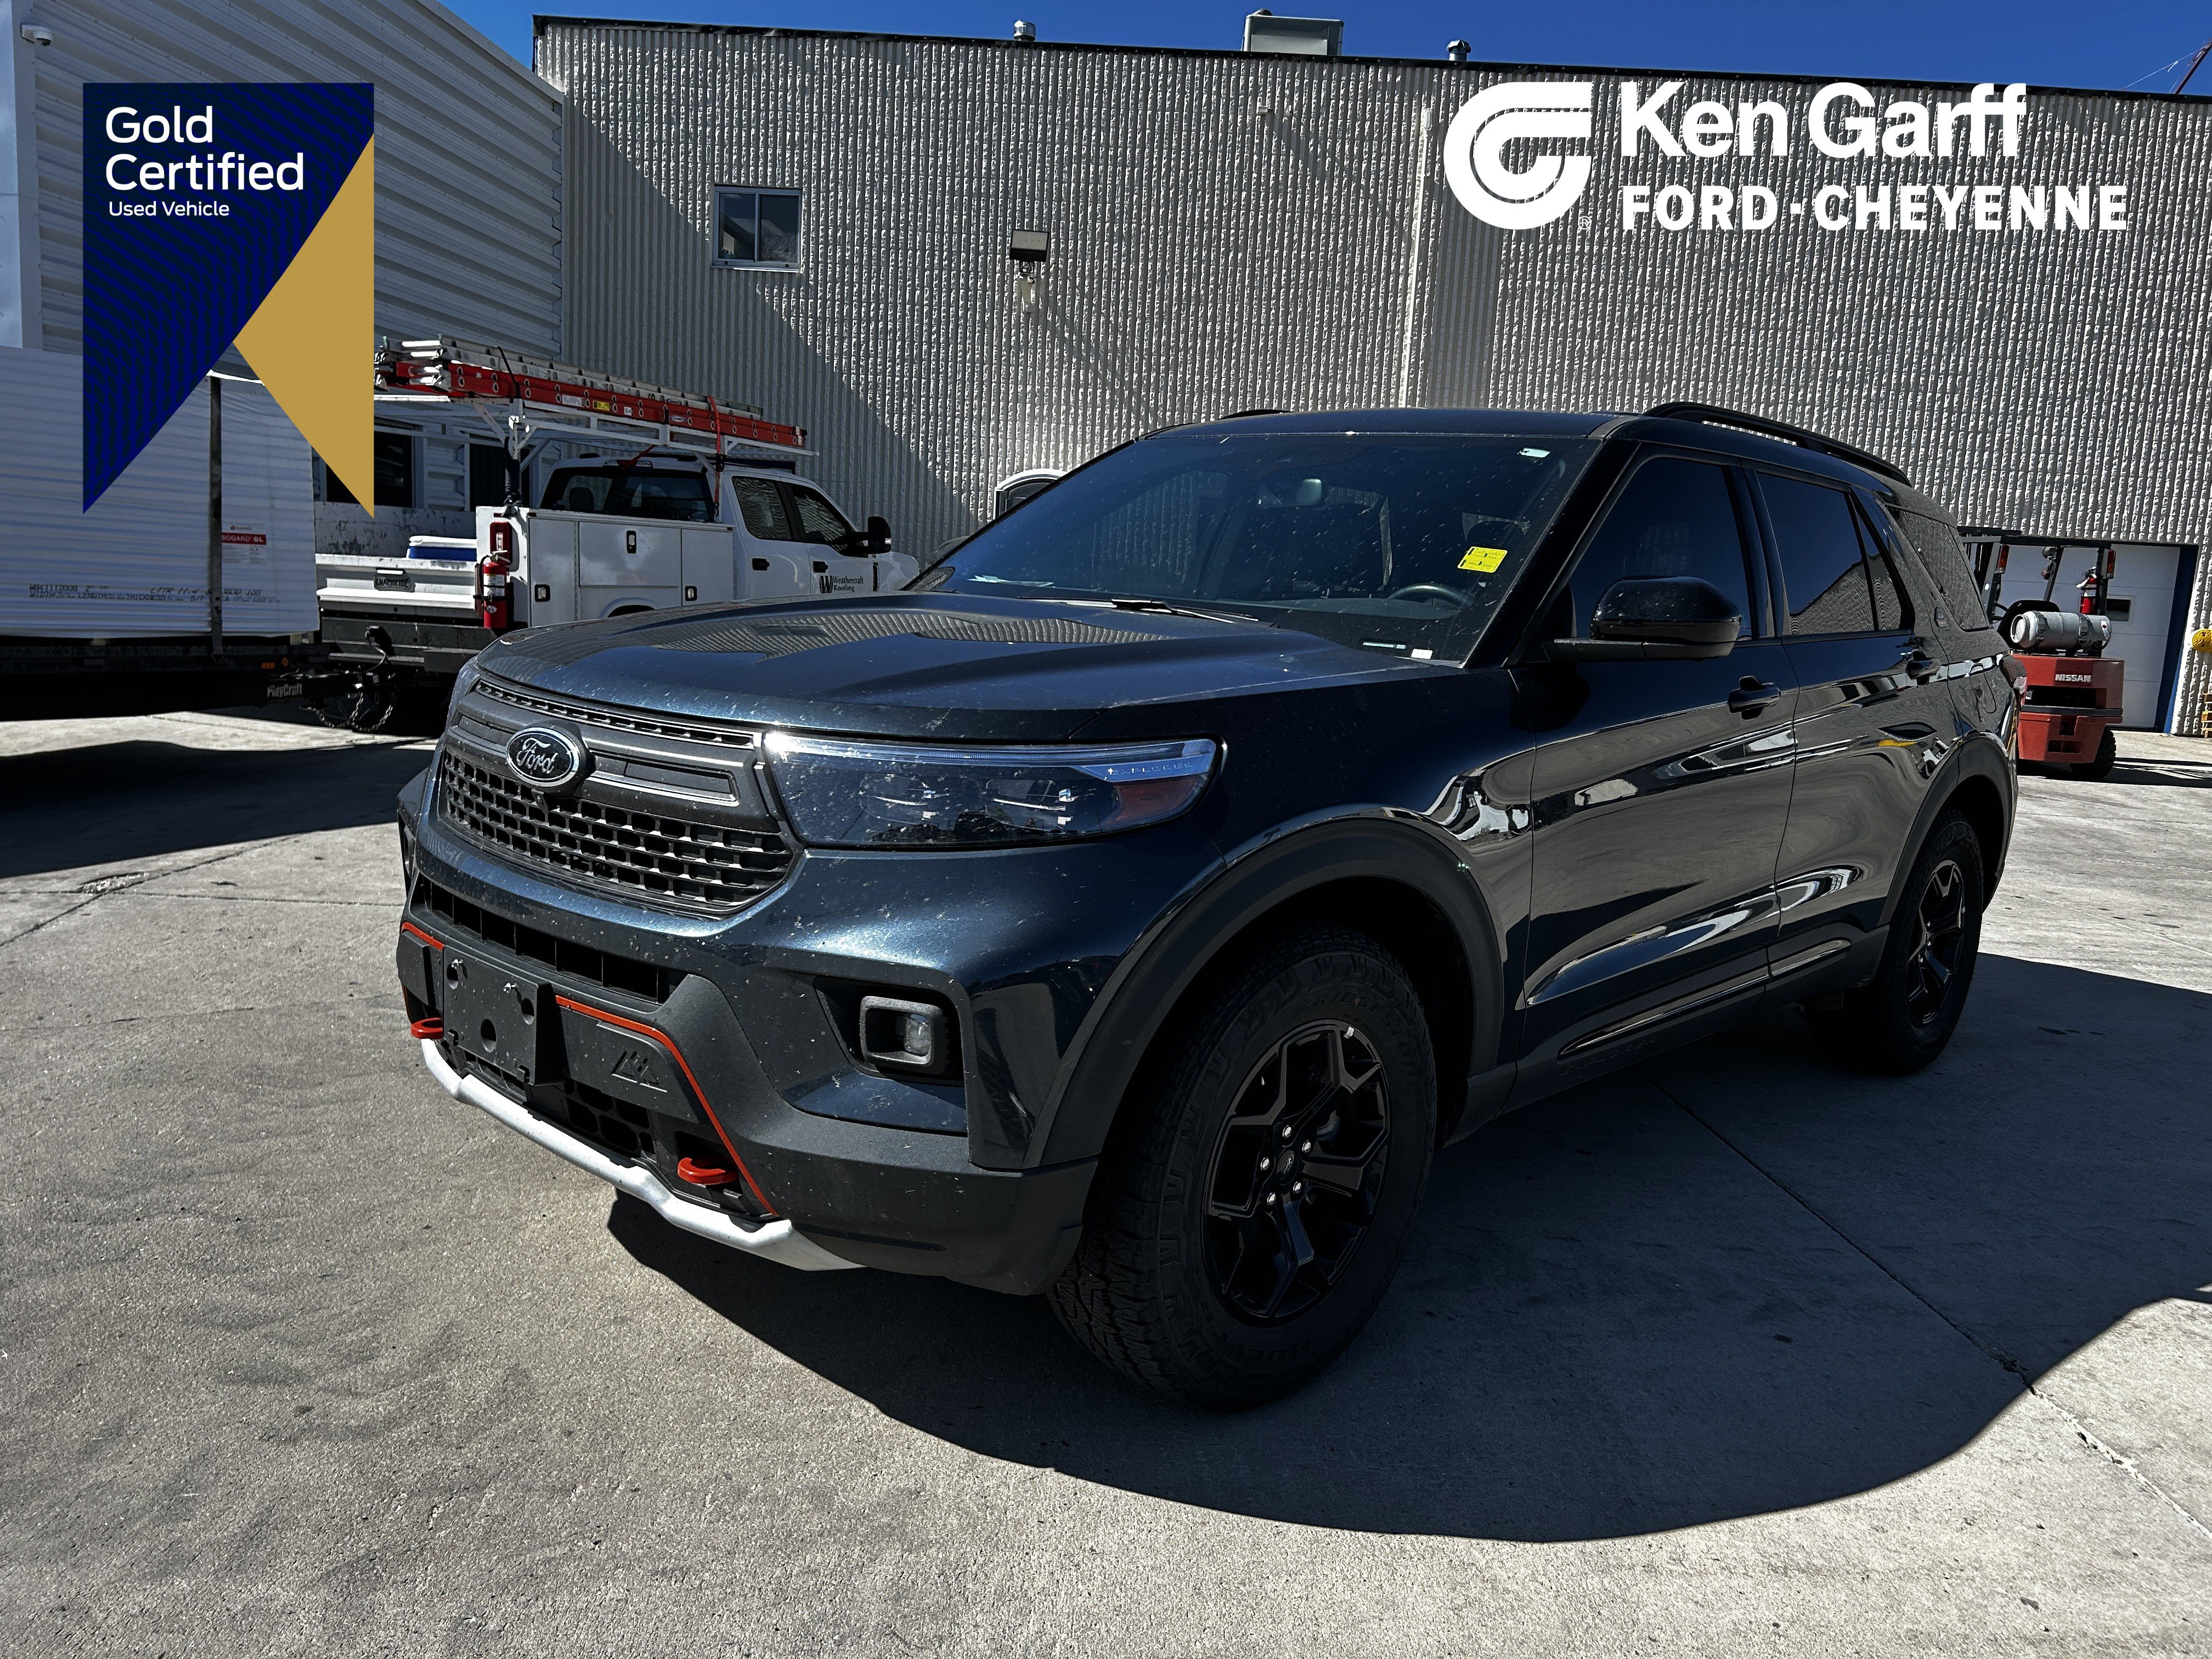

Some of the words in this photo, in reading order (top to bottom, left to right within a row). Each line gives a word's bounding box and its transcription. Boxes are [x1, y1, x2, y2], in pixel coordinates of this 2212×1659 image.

[833, 576, 864, 584] Weathercraft
[2055, 674, 2092, 682] NISSAN
[516, 737, 558, 774] Ford
[1108, 762, 1193, 776] EXPLORER
